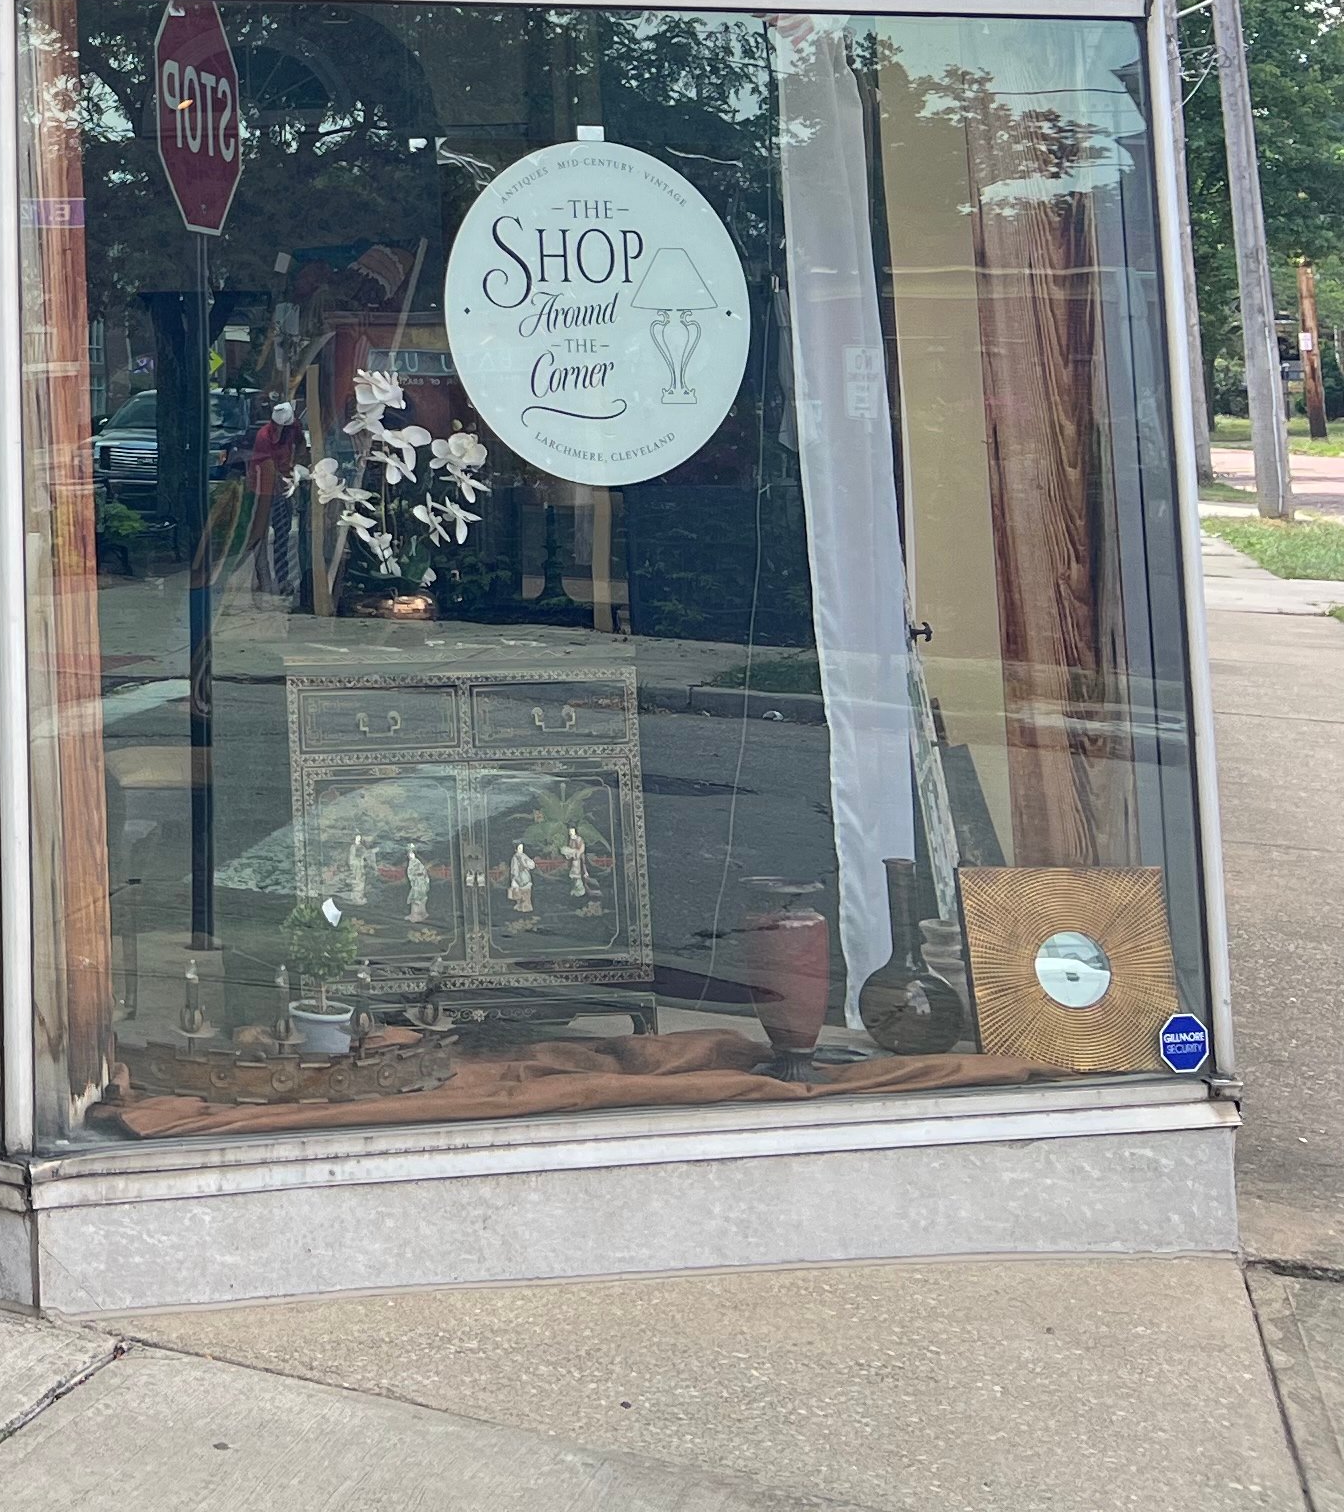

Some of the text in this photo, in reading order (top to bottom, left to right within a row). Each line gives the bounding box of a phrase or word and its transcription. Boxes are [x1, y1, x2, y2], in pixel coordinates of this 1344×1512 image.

[499, 165, 550, 205] ANTIQUES
[642, 171, 688, 208] VINTAGE
[567, 199, 614, 219] THE
[518, 290, 621, 338] Around
[563, 338, 598, 354] THE
[530, 349, 616, 399] Corner
[534, 430, 677, 464] LARCHMERE, CLEVELAND
[1163, 1031, 1205, 1044] GILLMORE
[1166, 1043, 1203, 1055] SECURITY
